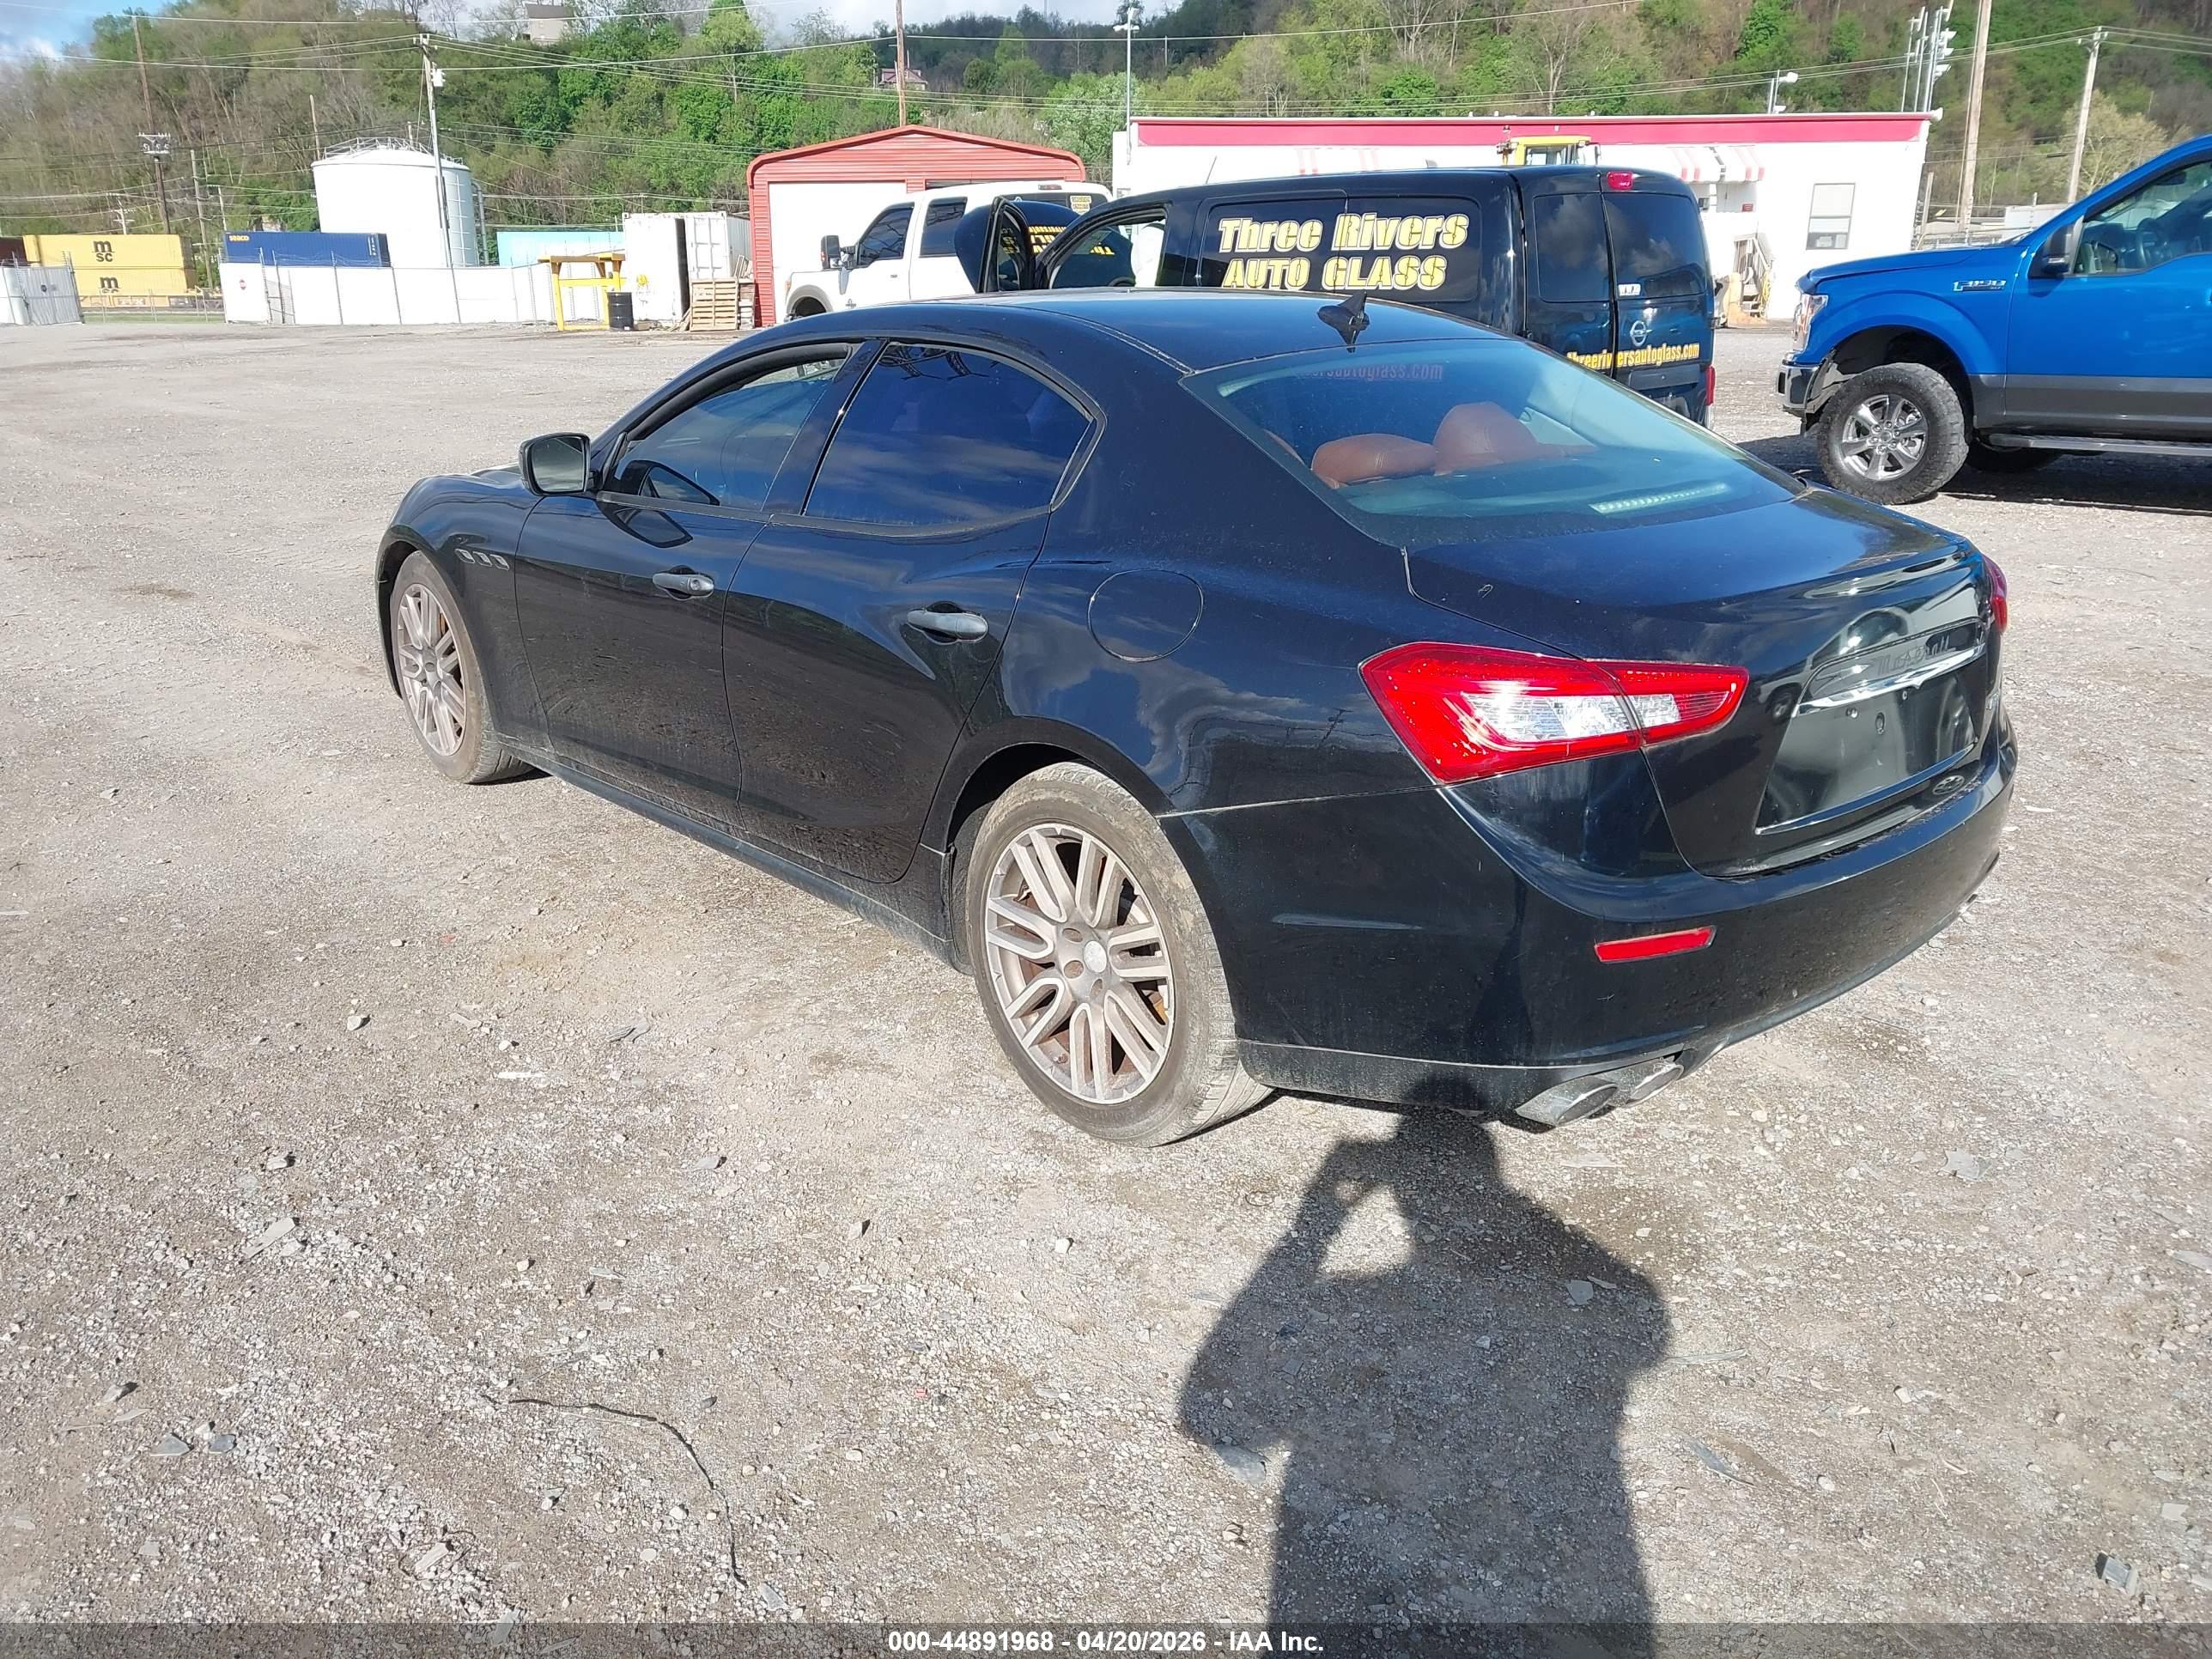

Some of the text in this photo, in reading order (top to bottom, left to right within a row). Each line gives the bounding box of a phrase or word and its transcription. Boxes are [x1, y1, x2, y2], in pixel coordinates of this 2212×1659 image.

[1219, 212, 1469, 252] Three Rivers
[1222, 255, 1448, 290] AUTO GLASS
